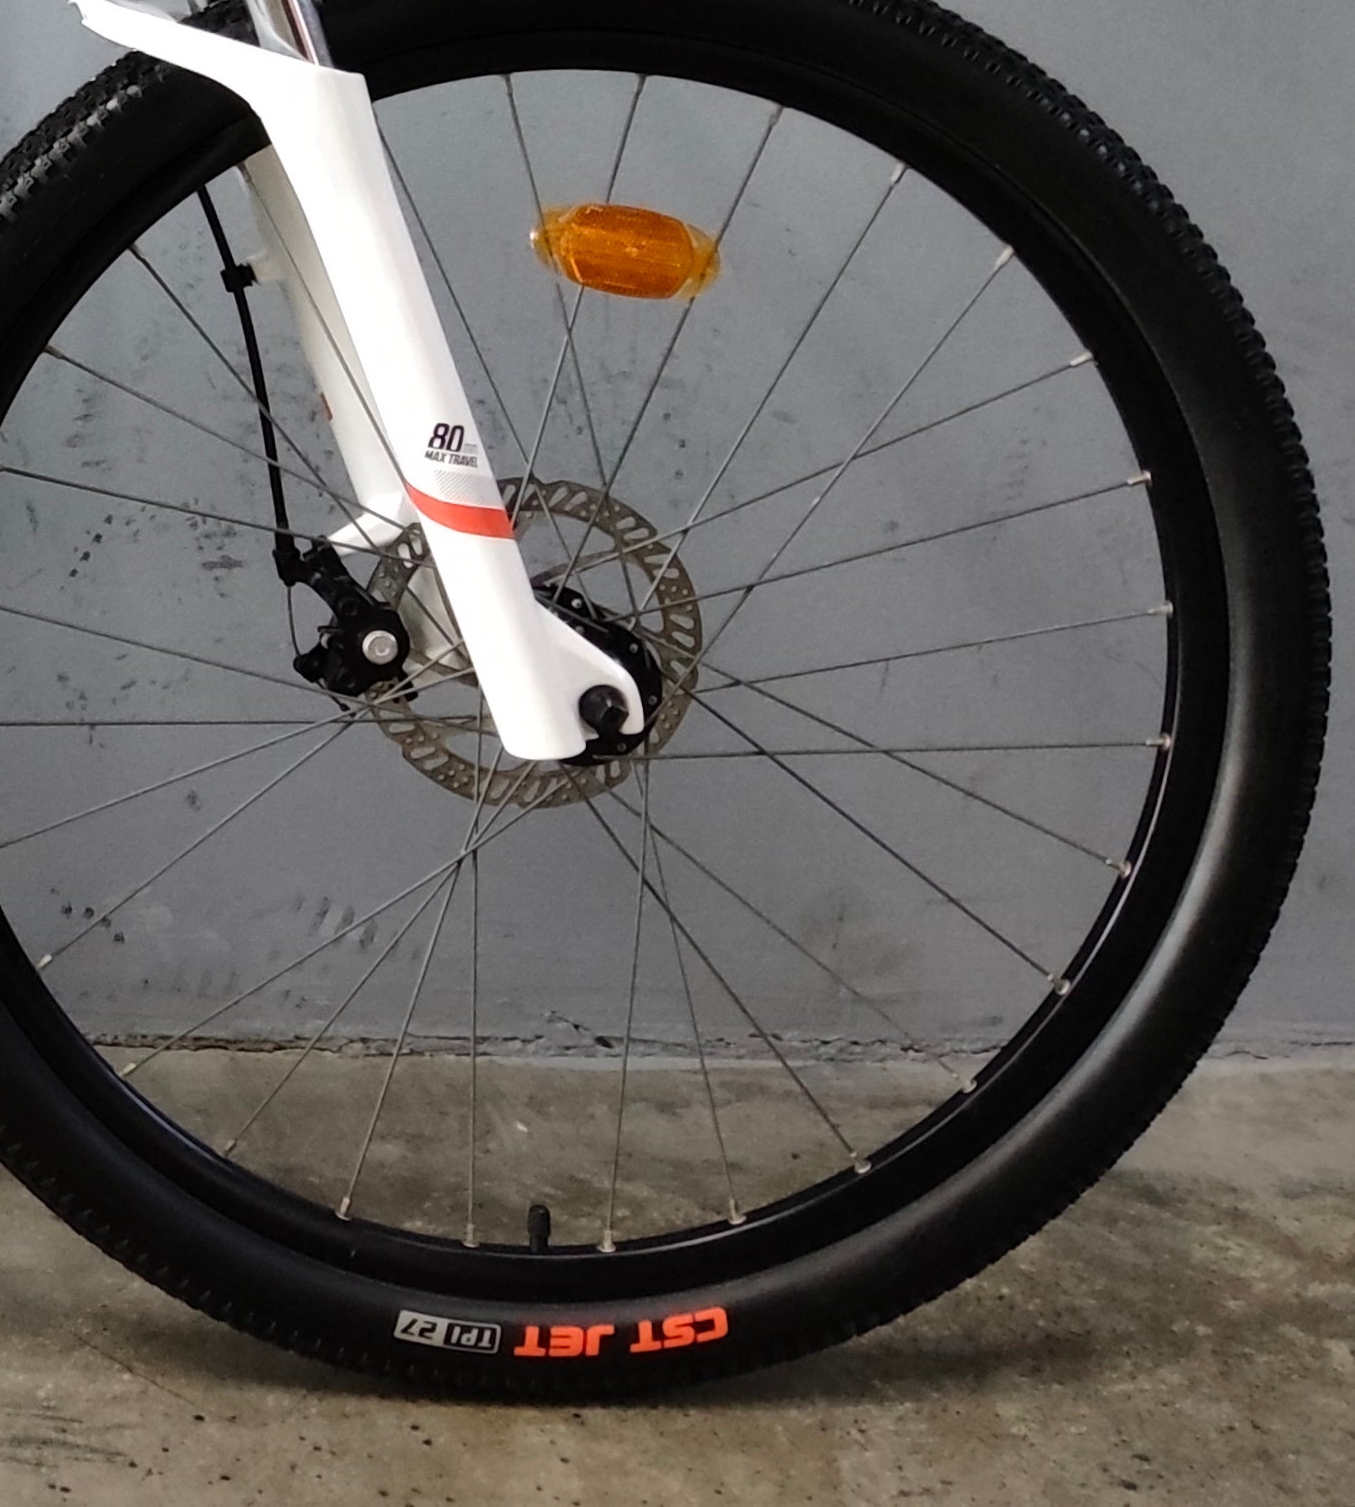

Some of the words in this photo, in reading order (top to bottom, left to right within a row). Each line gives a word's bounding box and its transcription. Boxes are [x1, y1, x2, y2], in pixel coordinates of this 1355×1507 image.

[428, 423, 464, 452] 80
[424, 450, 447, 463] MAX
[448, 453, 478, 468] TRAVEL
[401, 1318, 437, 1340] 27
[447, 1324, 494, 1350] TPI
[513, 1324, 616, 1357] JET
[629, 1305, 730, 1355] CST
